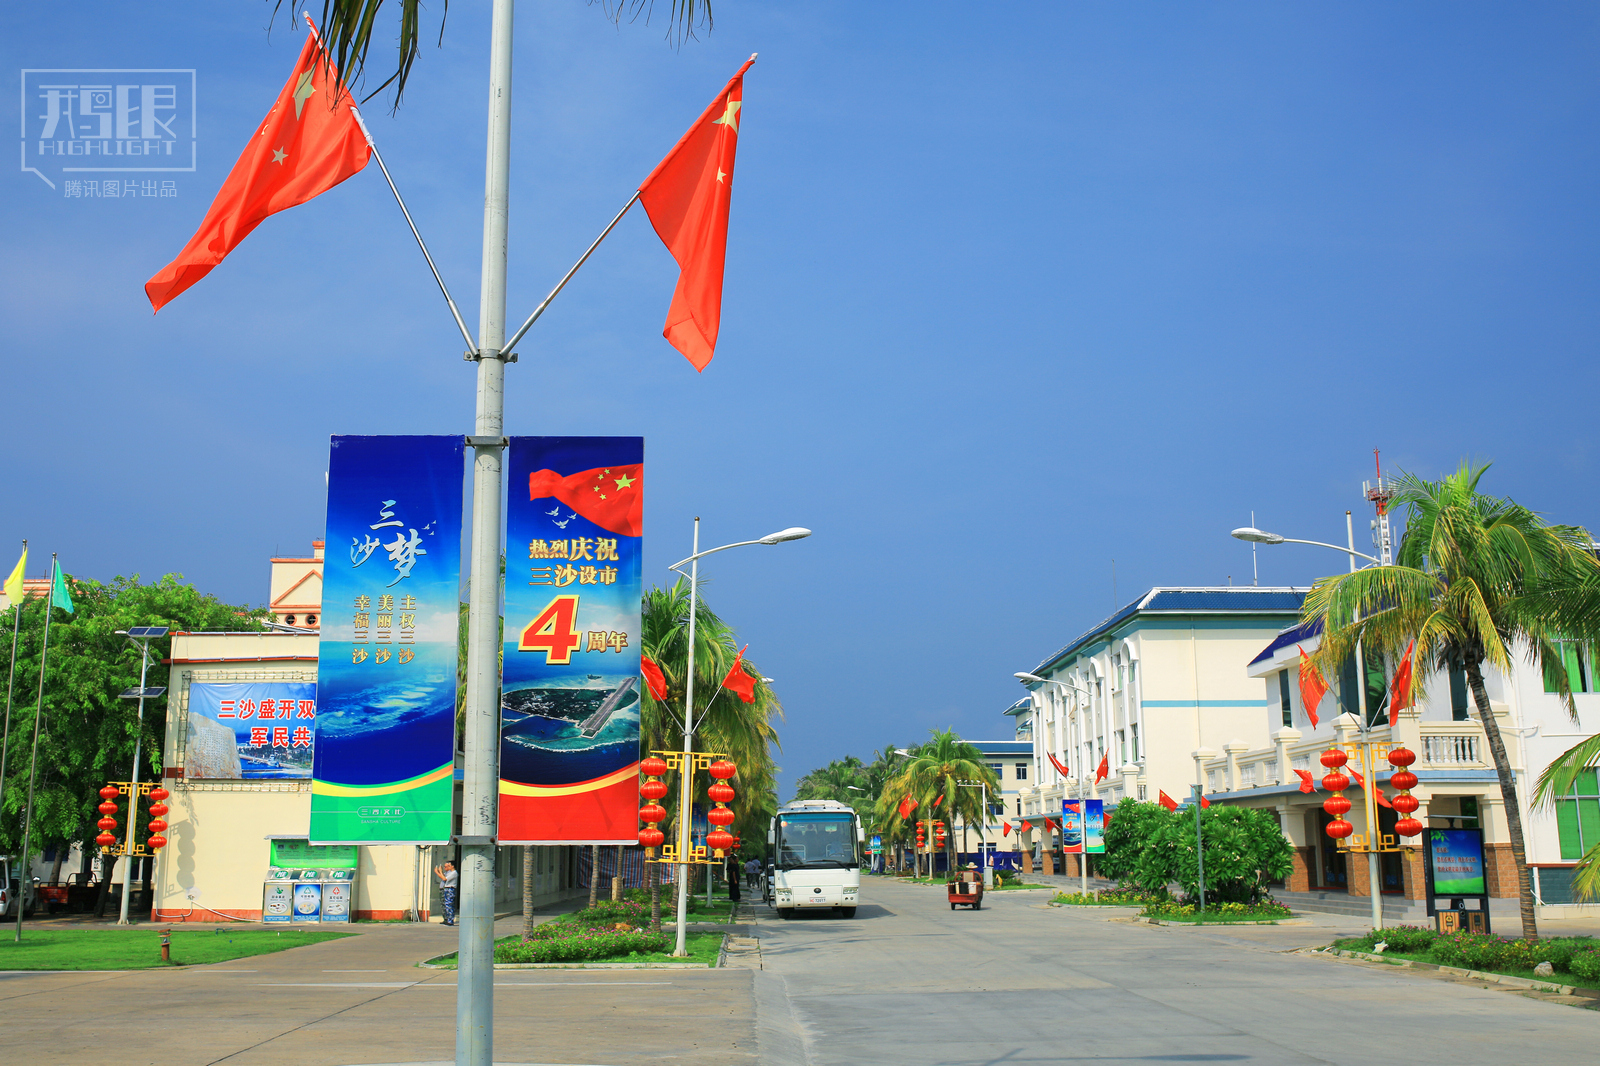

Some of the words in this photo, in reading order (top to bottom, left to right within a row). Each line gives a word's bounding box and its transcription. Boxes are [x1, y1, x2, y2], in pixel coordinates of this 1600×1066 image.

[528, 536, 619, 561] 热烈庆祝
[528, 563, 619, 588] 三沙设市
[352, 594, 370, 664] 幸福三沙
[375, 594, 393, 664] 美丽三沙
[398, 594, 416, 664] 主权三沙
[218, 699, 315, 719] 三沙盛开双
[250, 727, 311, 747] 军民共
